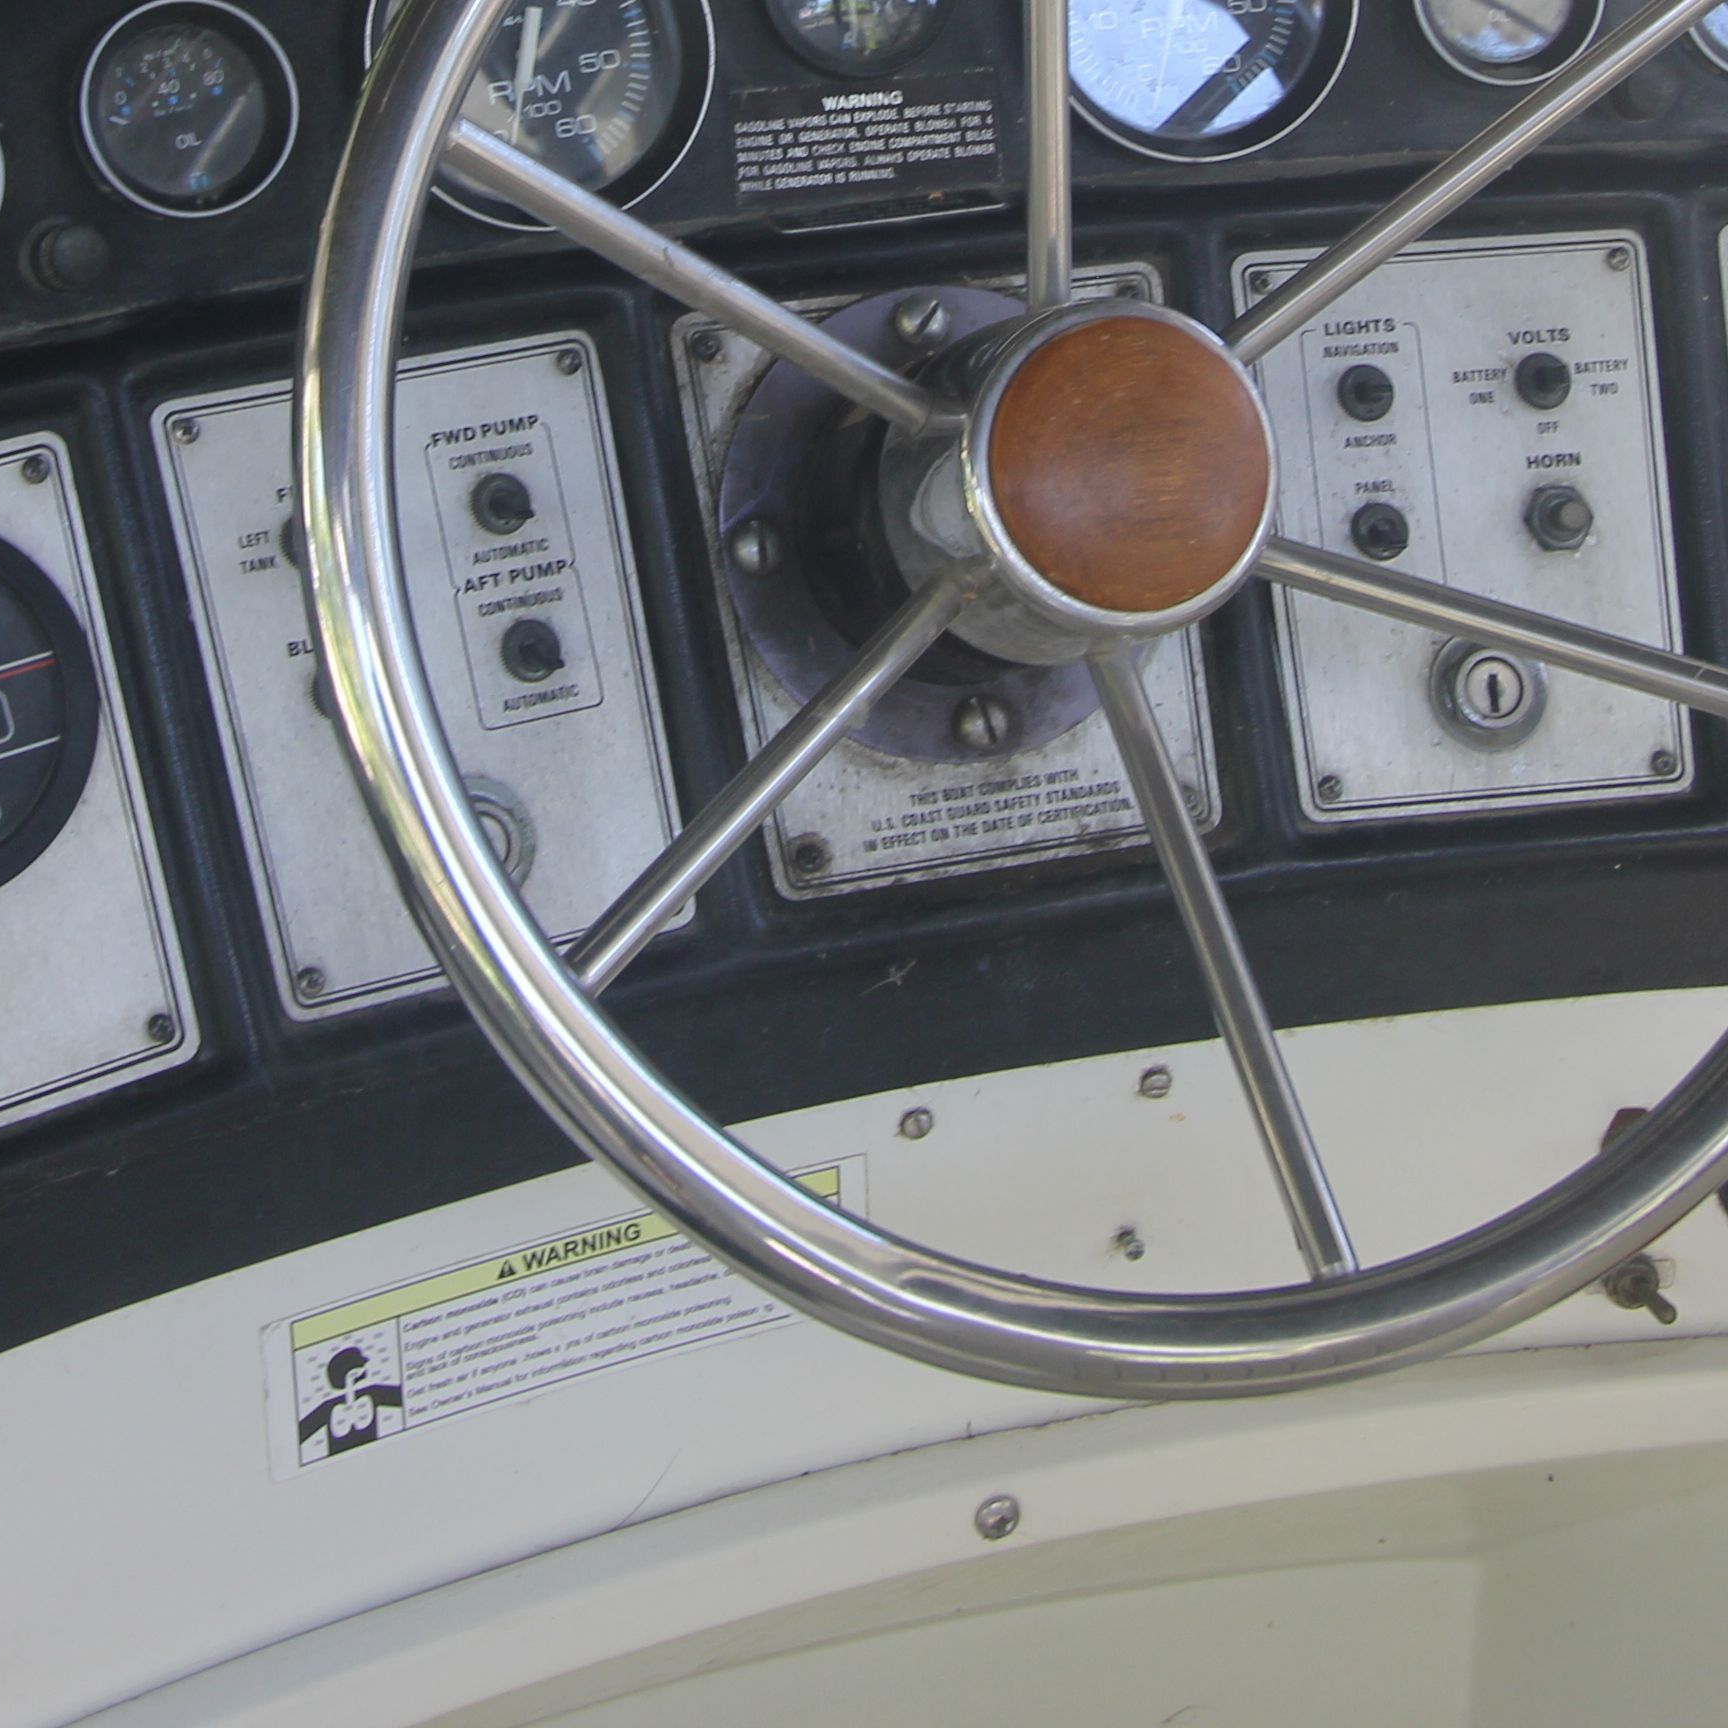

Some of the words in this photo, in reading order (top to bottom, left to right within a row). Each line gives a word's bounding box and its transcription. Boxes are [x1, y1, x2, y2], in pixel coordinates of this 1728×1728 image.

[577, 48, 622, 74] 50
[821, 90, 904, 112] WARNING
[553, 114, 598, 139] 60
[1323, 318, 1397, 337] LIGHTS
[1507, 327, 1572, 346] VOLTS
[1322, 341, 1401, 359] NAVIGATION
[1451, 367, 1509, 384] BATTERY
[1573, 358, 1630, 375] BATTERY
[1468, 390, 1496, 405] ONE
[1589, 381, 1619, 396] TWO
[430, 426, 477, 448] FWD
[480, 413, 539, 439] PUMP
[1536, 419, 1560, 435] OFF
[1343, 432, 1398, 450] ANCHOR
[448, 441, 534, 471] CONTINUOUS
[1525, 451, 1582, 470] HORN
[1353, 479, 1396, 495] PANEL
[237, 529, 272, 550] LEFT
[473, 536, 549, 566] AUTOMATIC
[239, 555, 277, 575] TANK
[463, 572, 502, 595] AFT
[509, 558, 568, 584] PUMP
[477, 586, 564, 618] CONTINUOUS
[502, 682, 580, 713] AUTOMATIC
[909, 791, 939, 807] THIS
[942, 785, 975, 802] BOAT
[978, 774, 1043, 797] COMPLIES
[1043, 768, 1079, 786] WITH
[901, 809, 945, 828] COAST
[947, 801, 991, 820] GUARD
[994, 792, 1042, 813] SAFETY
[1045, 780, 1122, 805] STANDARDS
[881, 831, 928, 850] EFFECT
[953, 822, 980, 838] THE
[981, 815, 1015, 834] DATE
[1017, 812, 1035, 829] OF
[522, 1222, 642, 1271] WARNING
[402, 1314, 443, 1334] Carbon
